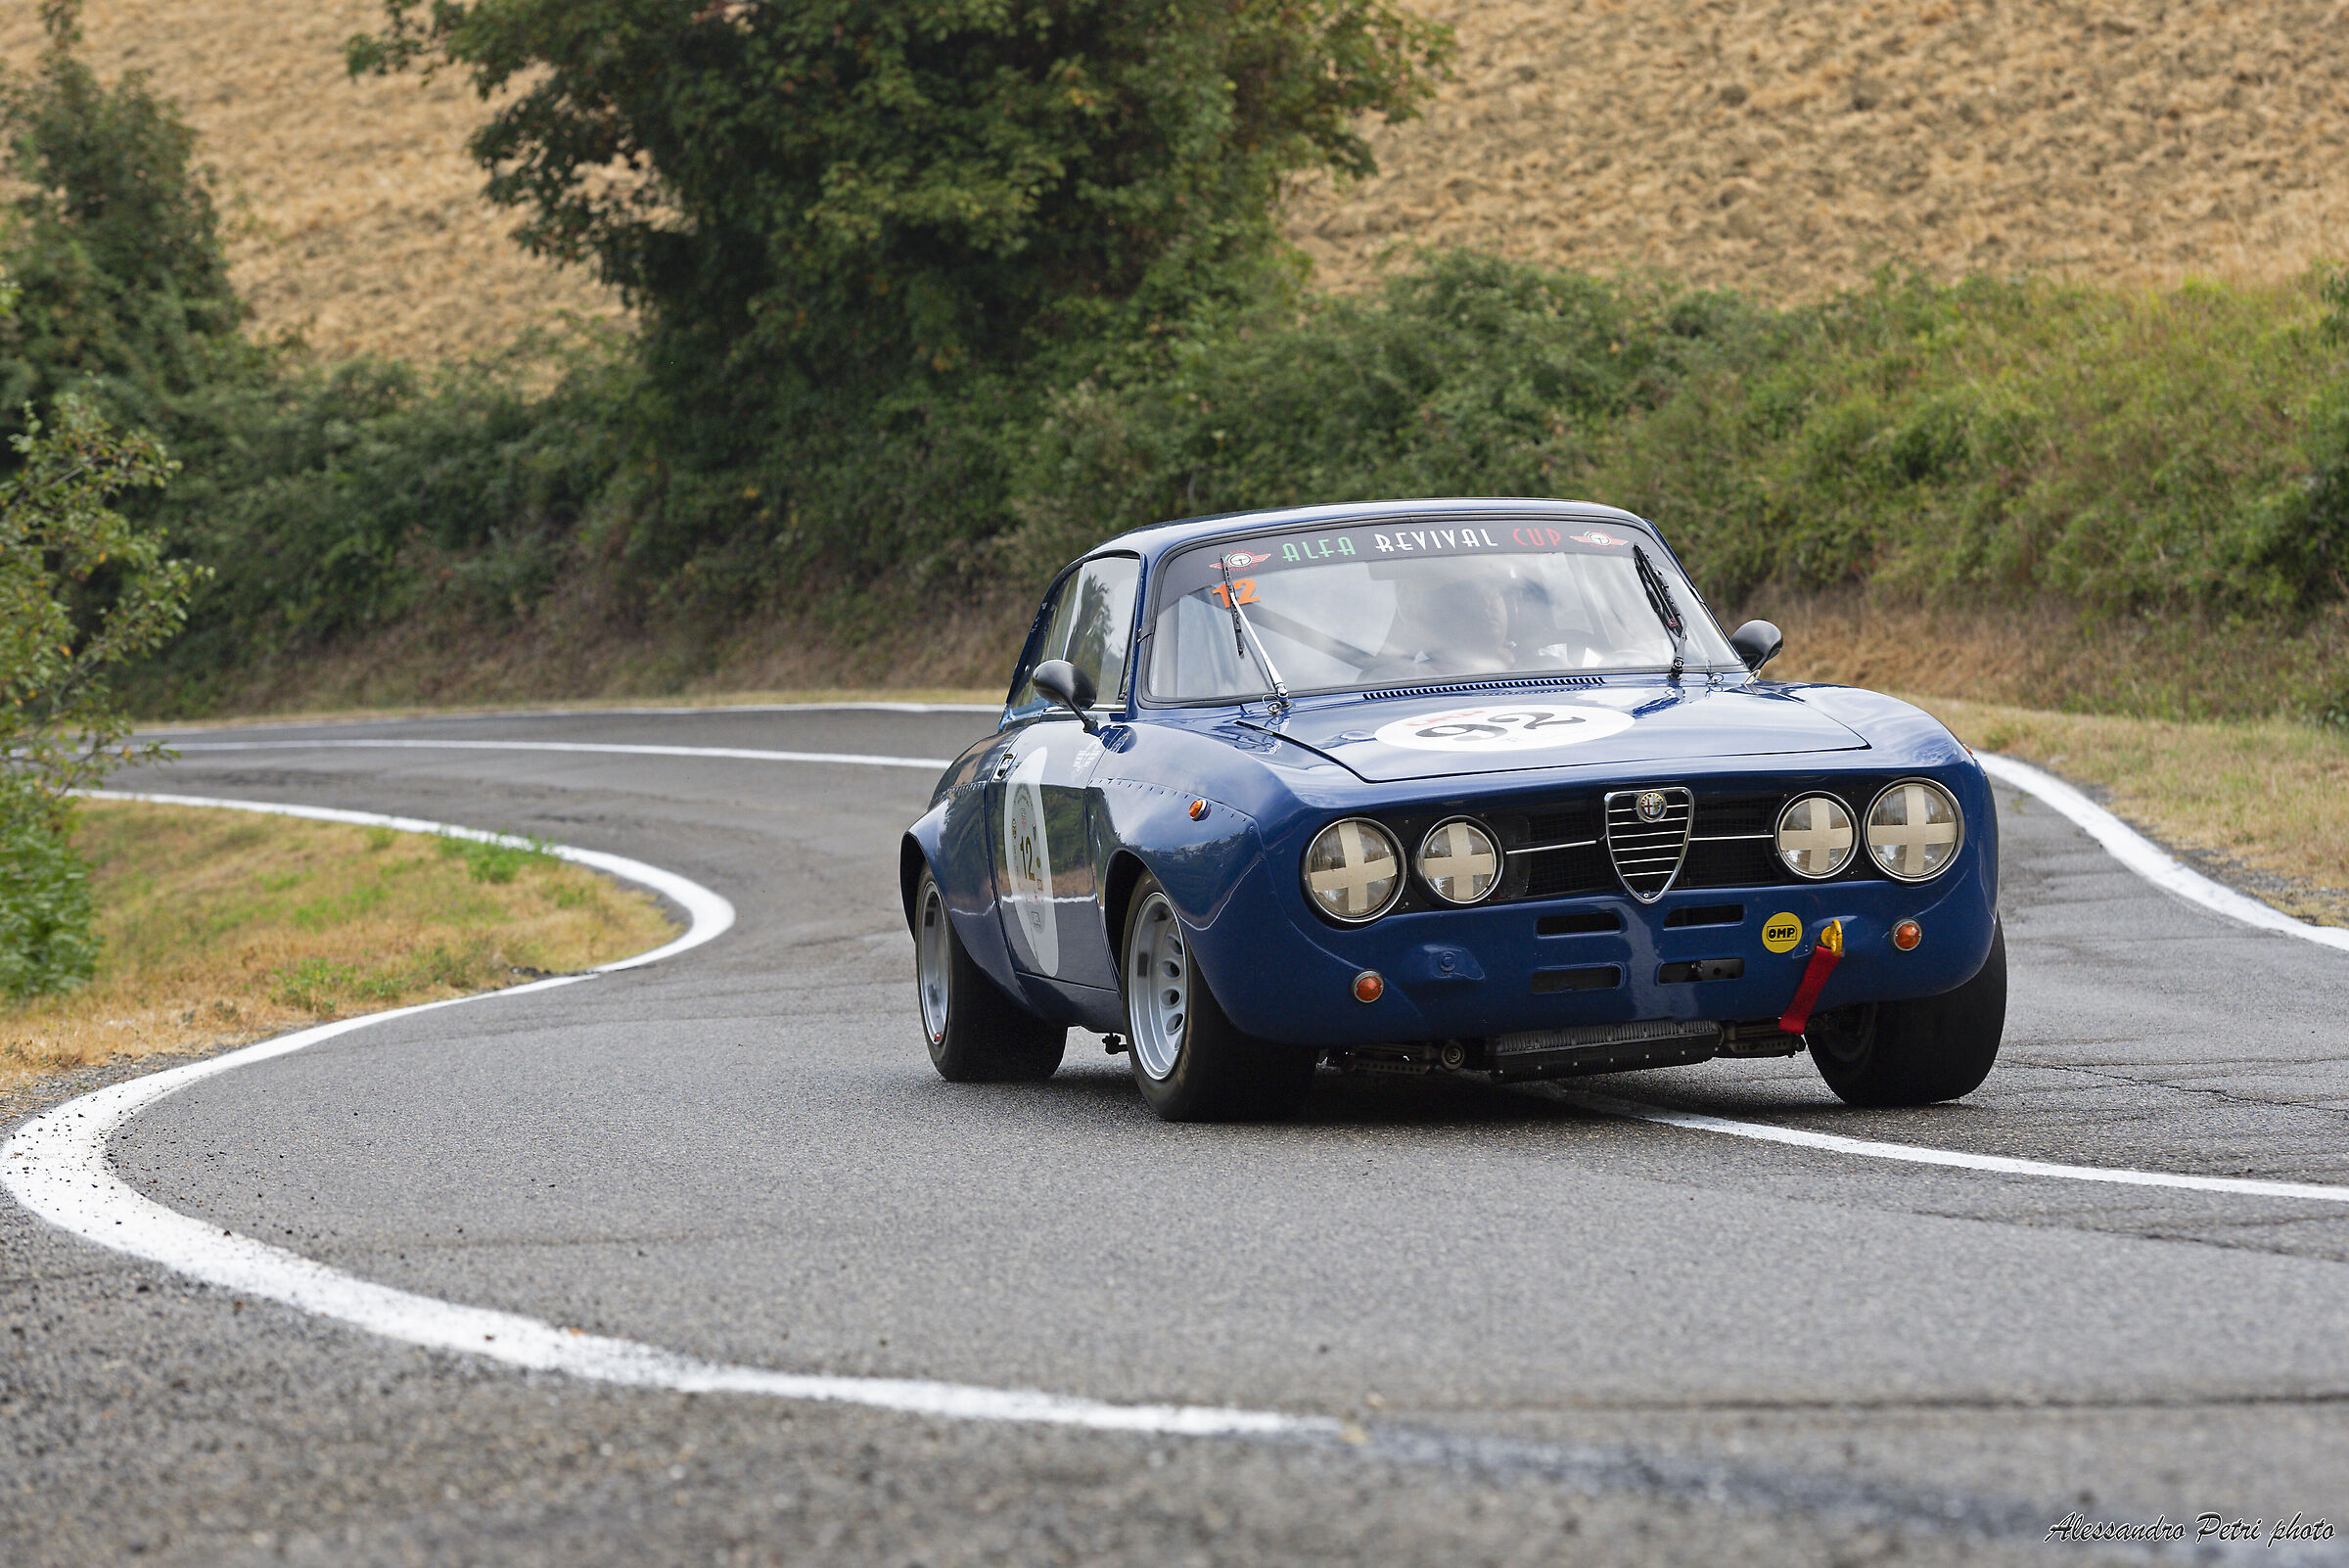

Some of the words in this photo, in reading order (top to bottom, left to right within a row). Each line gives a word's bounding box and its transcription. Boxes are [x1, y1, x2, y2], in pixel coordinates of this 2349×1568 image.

[1282, 536, 1357, 562] ALFA
[1374, 528, 1498, 553] REVIVAL
[1512, 528, 1561, 547] CUP
[1212, 578, 1261, 609] 12
[1019, 836, 1036, 882] 12
[1768, 927, 1796, 940] OMP
